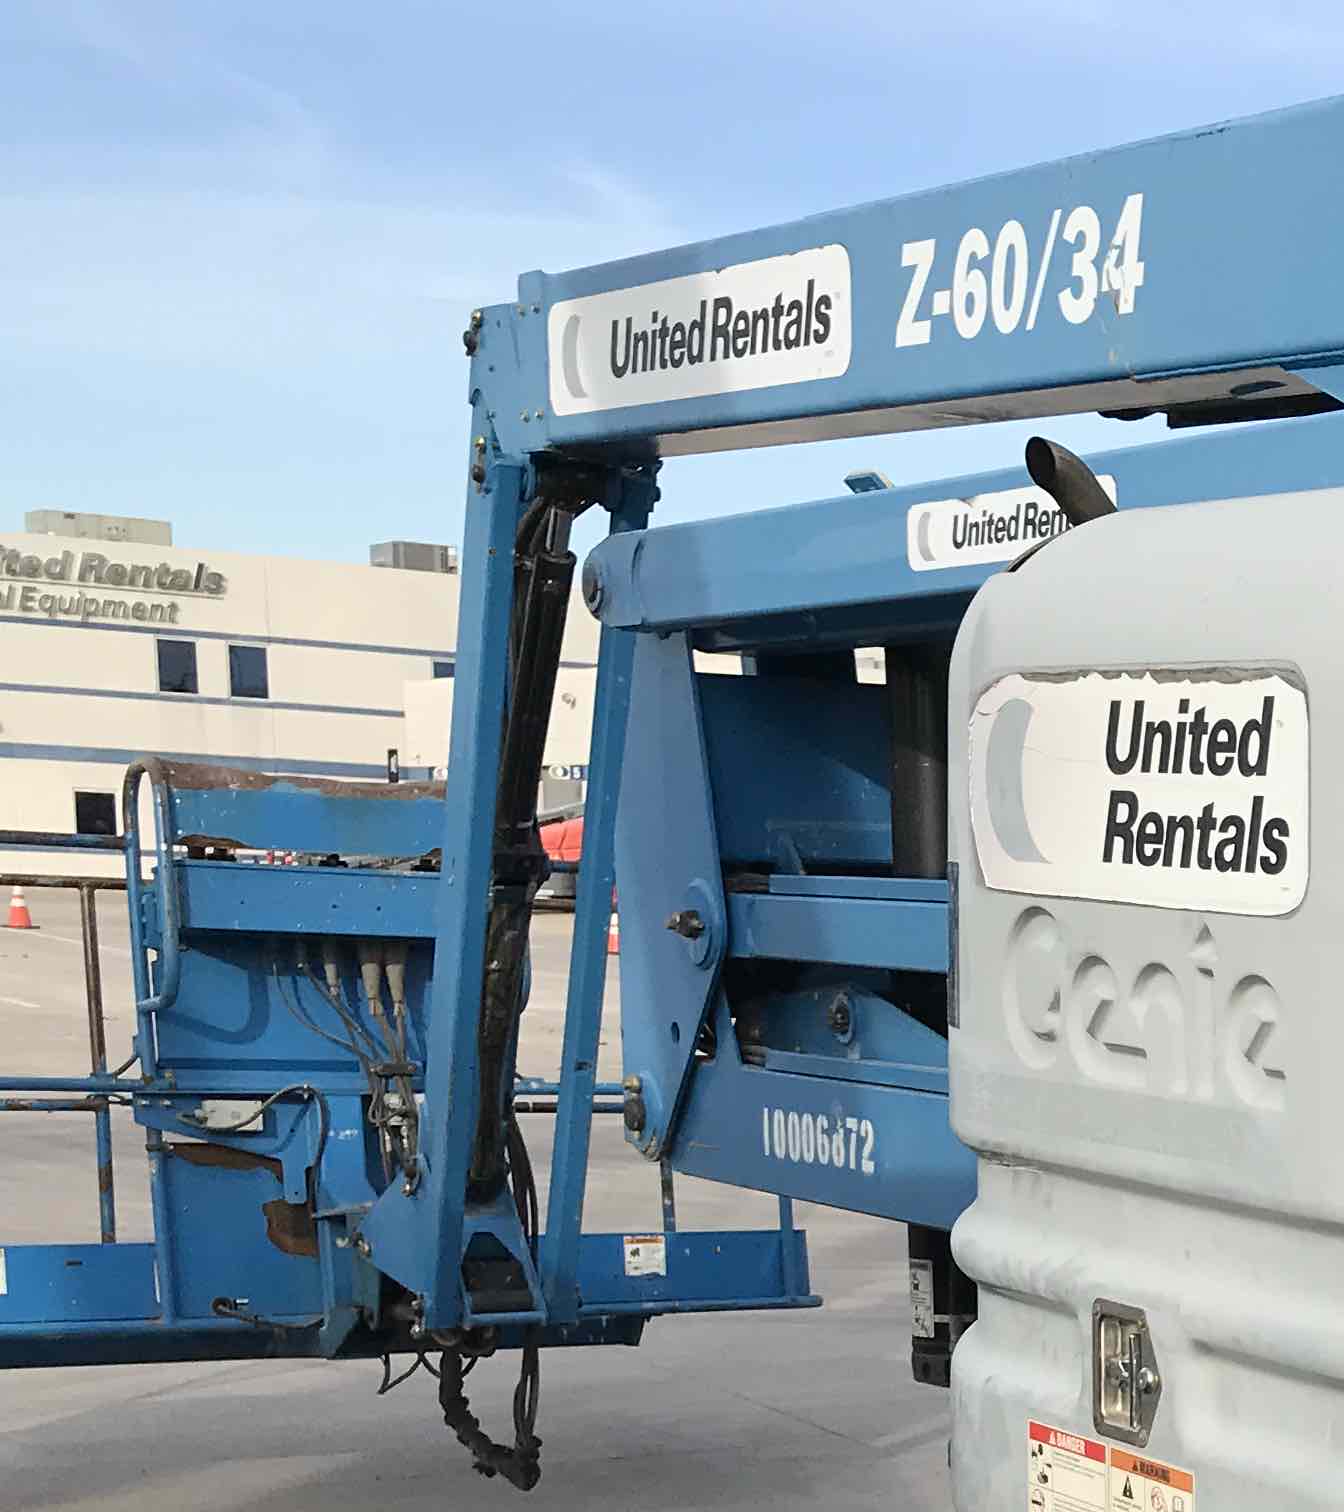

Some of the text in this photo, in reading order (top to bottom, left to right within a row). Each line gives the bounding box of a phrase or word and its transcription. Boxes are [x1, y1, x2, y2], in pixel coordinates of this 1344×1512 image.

[895, 191, 1146, 348] Z-60/34
[611, 279, 832, 378] United Rentals
[952, 503, 1021, 550] United
[20, 586, 179, 624] Equipment
[78, 552, 227, 595] Rentals
[1105, 696, 1275, 777] United
[1102, 790, 1290, 876] Rentals
[1002, 905, 1289, 1112] Genie
